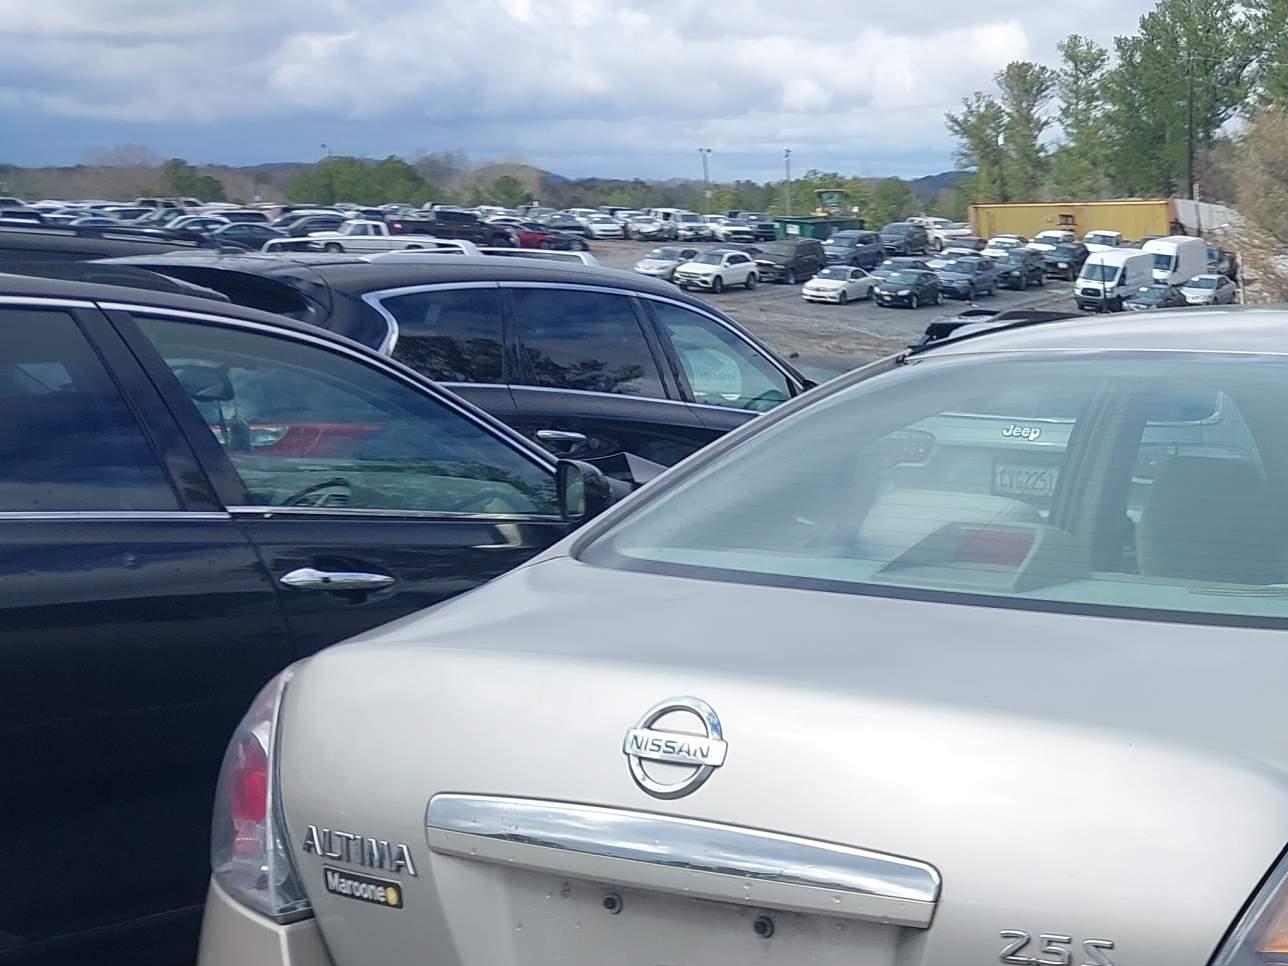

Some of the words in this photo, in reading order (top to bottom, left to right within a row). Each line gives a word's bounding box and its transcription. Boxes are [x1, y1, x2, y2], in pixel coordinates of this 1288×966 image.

[1002, 423, 1041, 441] Jeep
[630, 734, 710, 759] NISSAN
[302, 824, 418, 877] ALTIMA
[326, 870, 387, 903] Maroone
